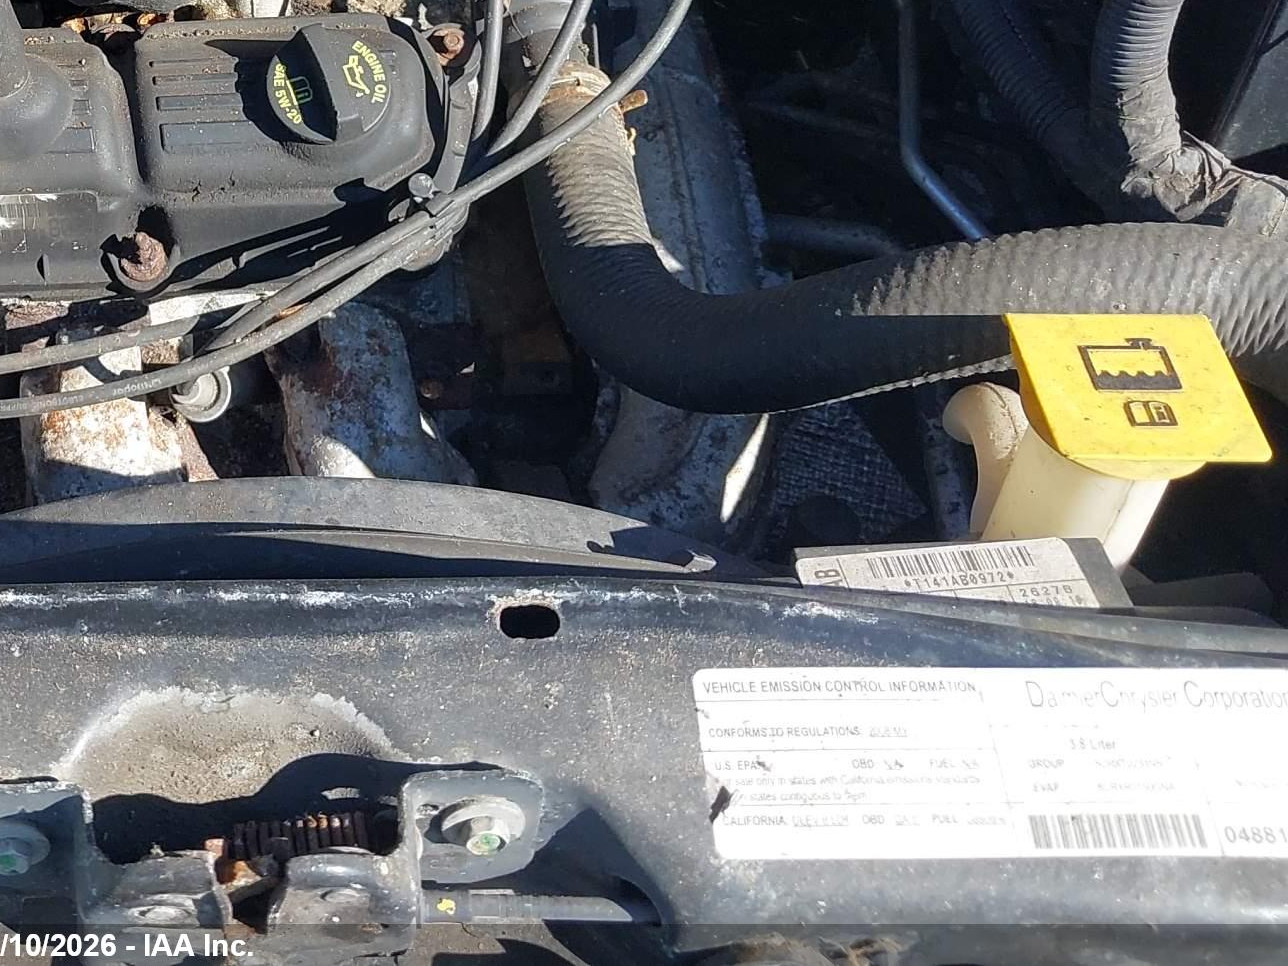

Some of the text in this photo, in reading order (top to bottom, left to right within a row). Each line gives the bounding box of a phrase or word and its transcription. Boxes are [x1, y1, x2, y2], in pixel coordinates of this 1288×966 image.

[351, 40, 387, 103] ENGINE OIL
[273, 63, 303, 125] SAE 5W-20
[702, 680, 976, 694] VEHICLE EMISSION CONTROL INFORMATION
[708, 726, 768, 738] CONFORMS
